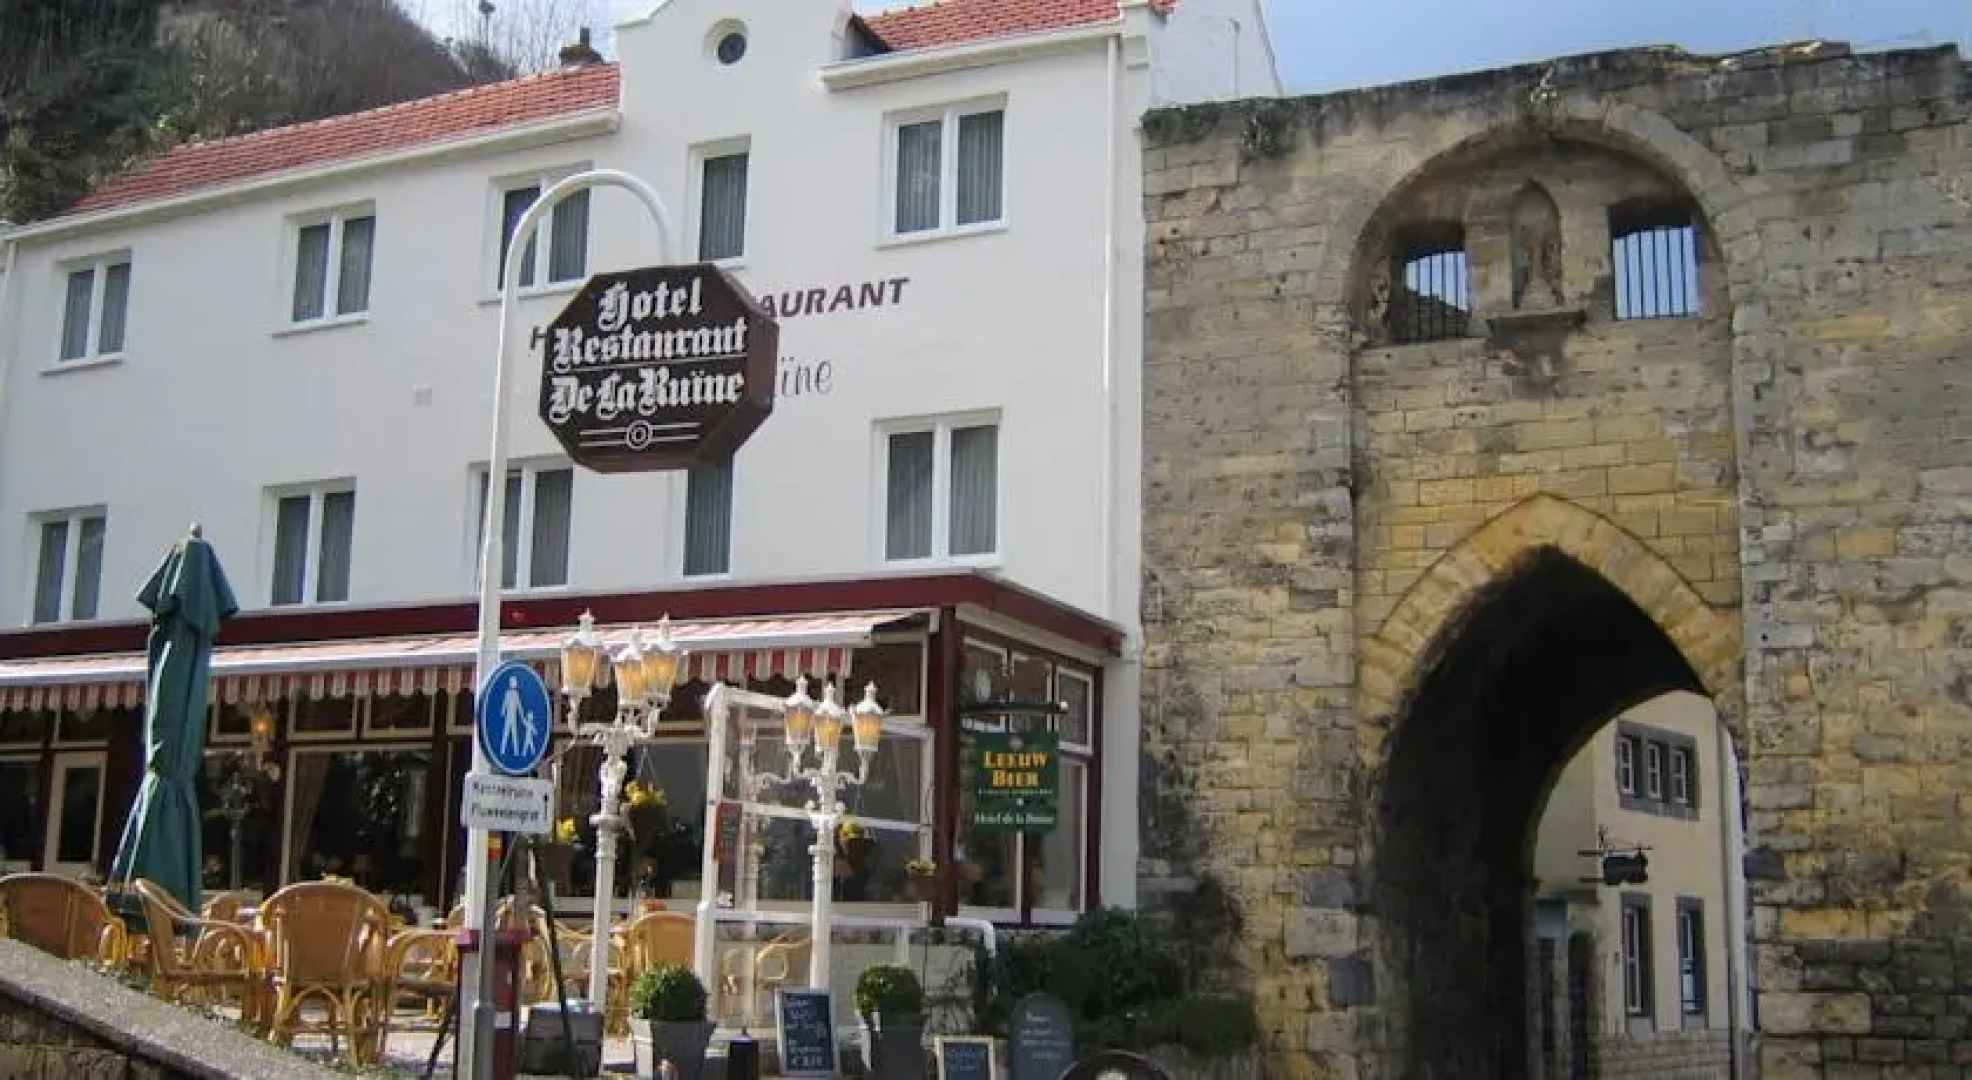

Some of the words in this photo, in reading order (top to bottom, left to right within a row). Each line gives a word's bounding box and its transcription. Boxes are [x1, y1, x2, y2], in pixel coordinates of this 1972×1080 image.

[598, 277, 702, 331] Hotel
[757, 277, 911, 318] AURANT
[553, 317, 747, 374] Restaurant
[780, 356, 834, 395] ïne
[993, 770, 1038, 787] BIER
